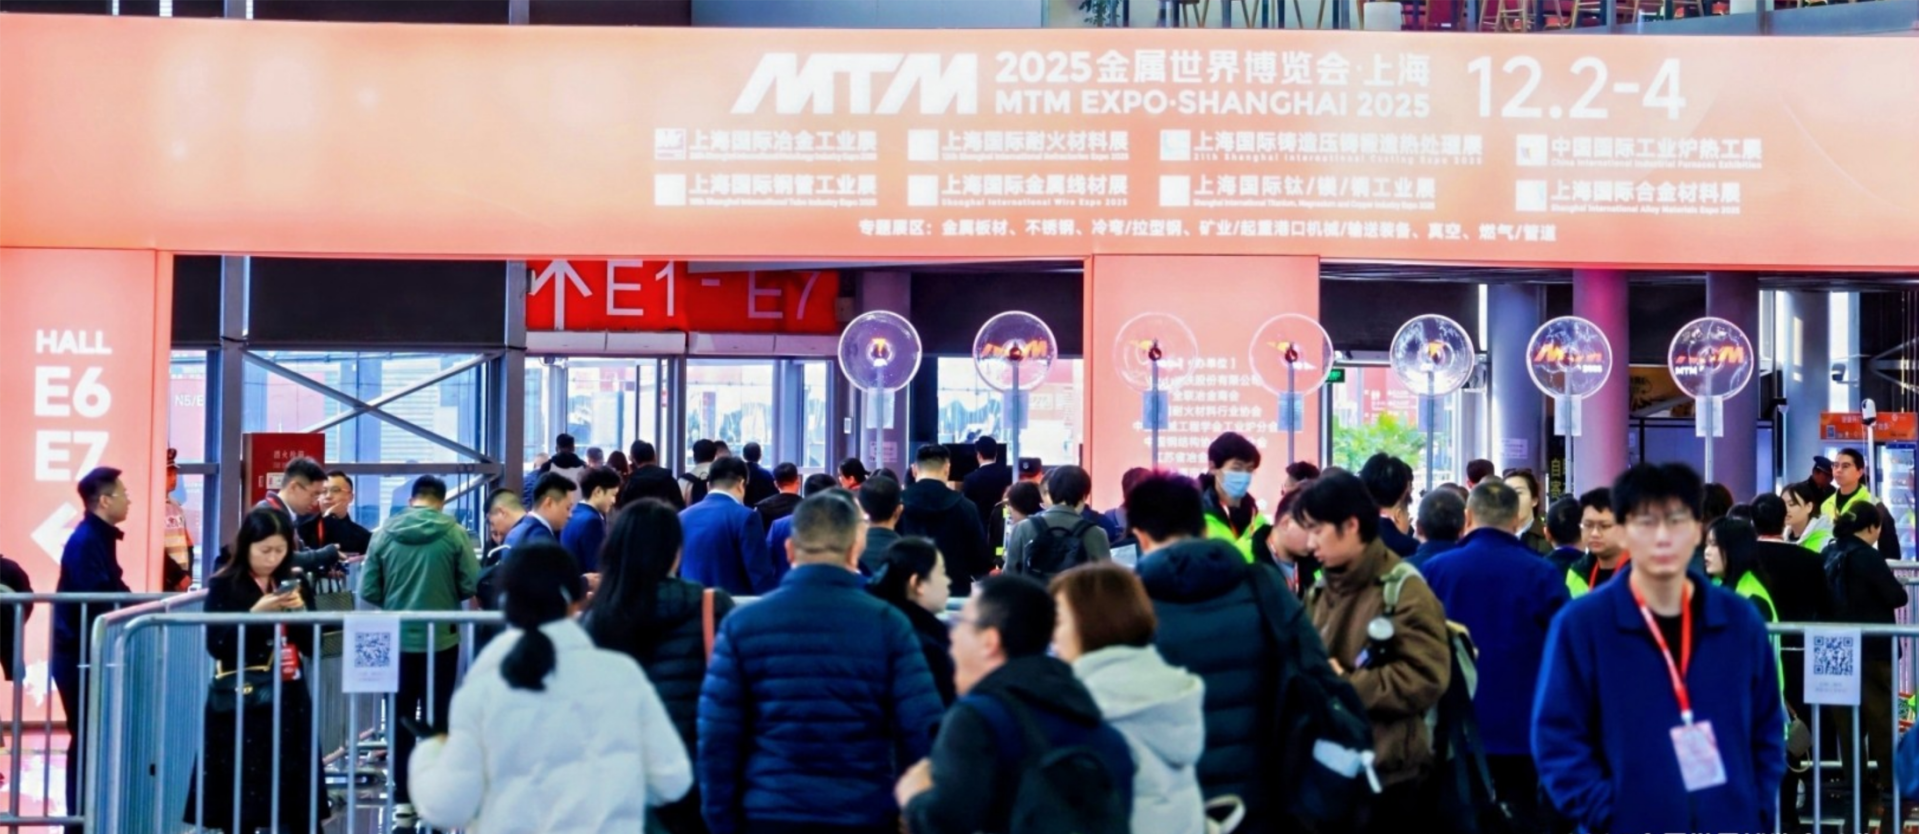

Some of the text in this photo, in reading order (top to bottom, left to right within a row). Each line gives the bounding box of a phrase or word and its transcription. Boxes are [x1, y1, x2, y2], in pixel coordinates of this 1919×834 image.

[995, 49, 1431, 87] 2025金属世界博览会·上海
[730, 52, 978, 114] MTM
[1467, 55, 1687, 120] 12.2-4
[995, 90, 1431, 118] MTM EXPO·SHANGHAI 2025
[689, 129, 877, 152] 上海国际冶金工业展
[941, 130, 1128, 152] 上海国际耐火材料展
[1551, 136, 1762, 160] 中国国际工业炉热工展
[941, 173, 1128, 195] 上海国际金属线材展
[1551, 179, 1740, 203] 上海国际合金材料展
[941, 198, 985, 208] Shanghai
[987, 198, 1051, 206] International
[606, 260, 675, 317] E1
[748, 271, 822, 321] E7
[36, 330, 112, 355] HALL
[34, 366, 111, 418] E6
[1167, 405, 1261, 418] 耐火材料行业协会
[34, 430, 110, 482] E7
